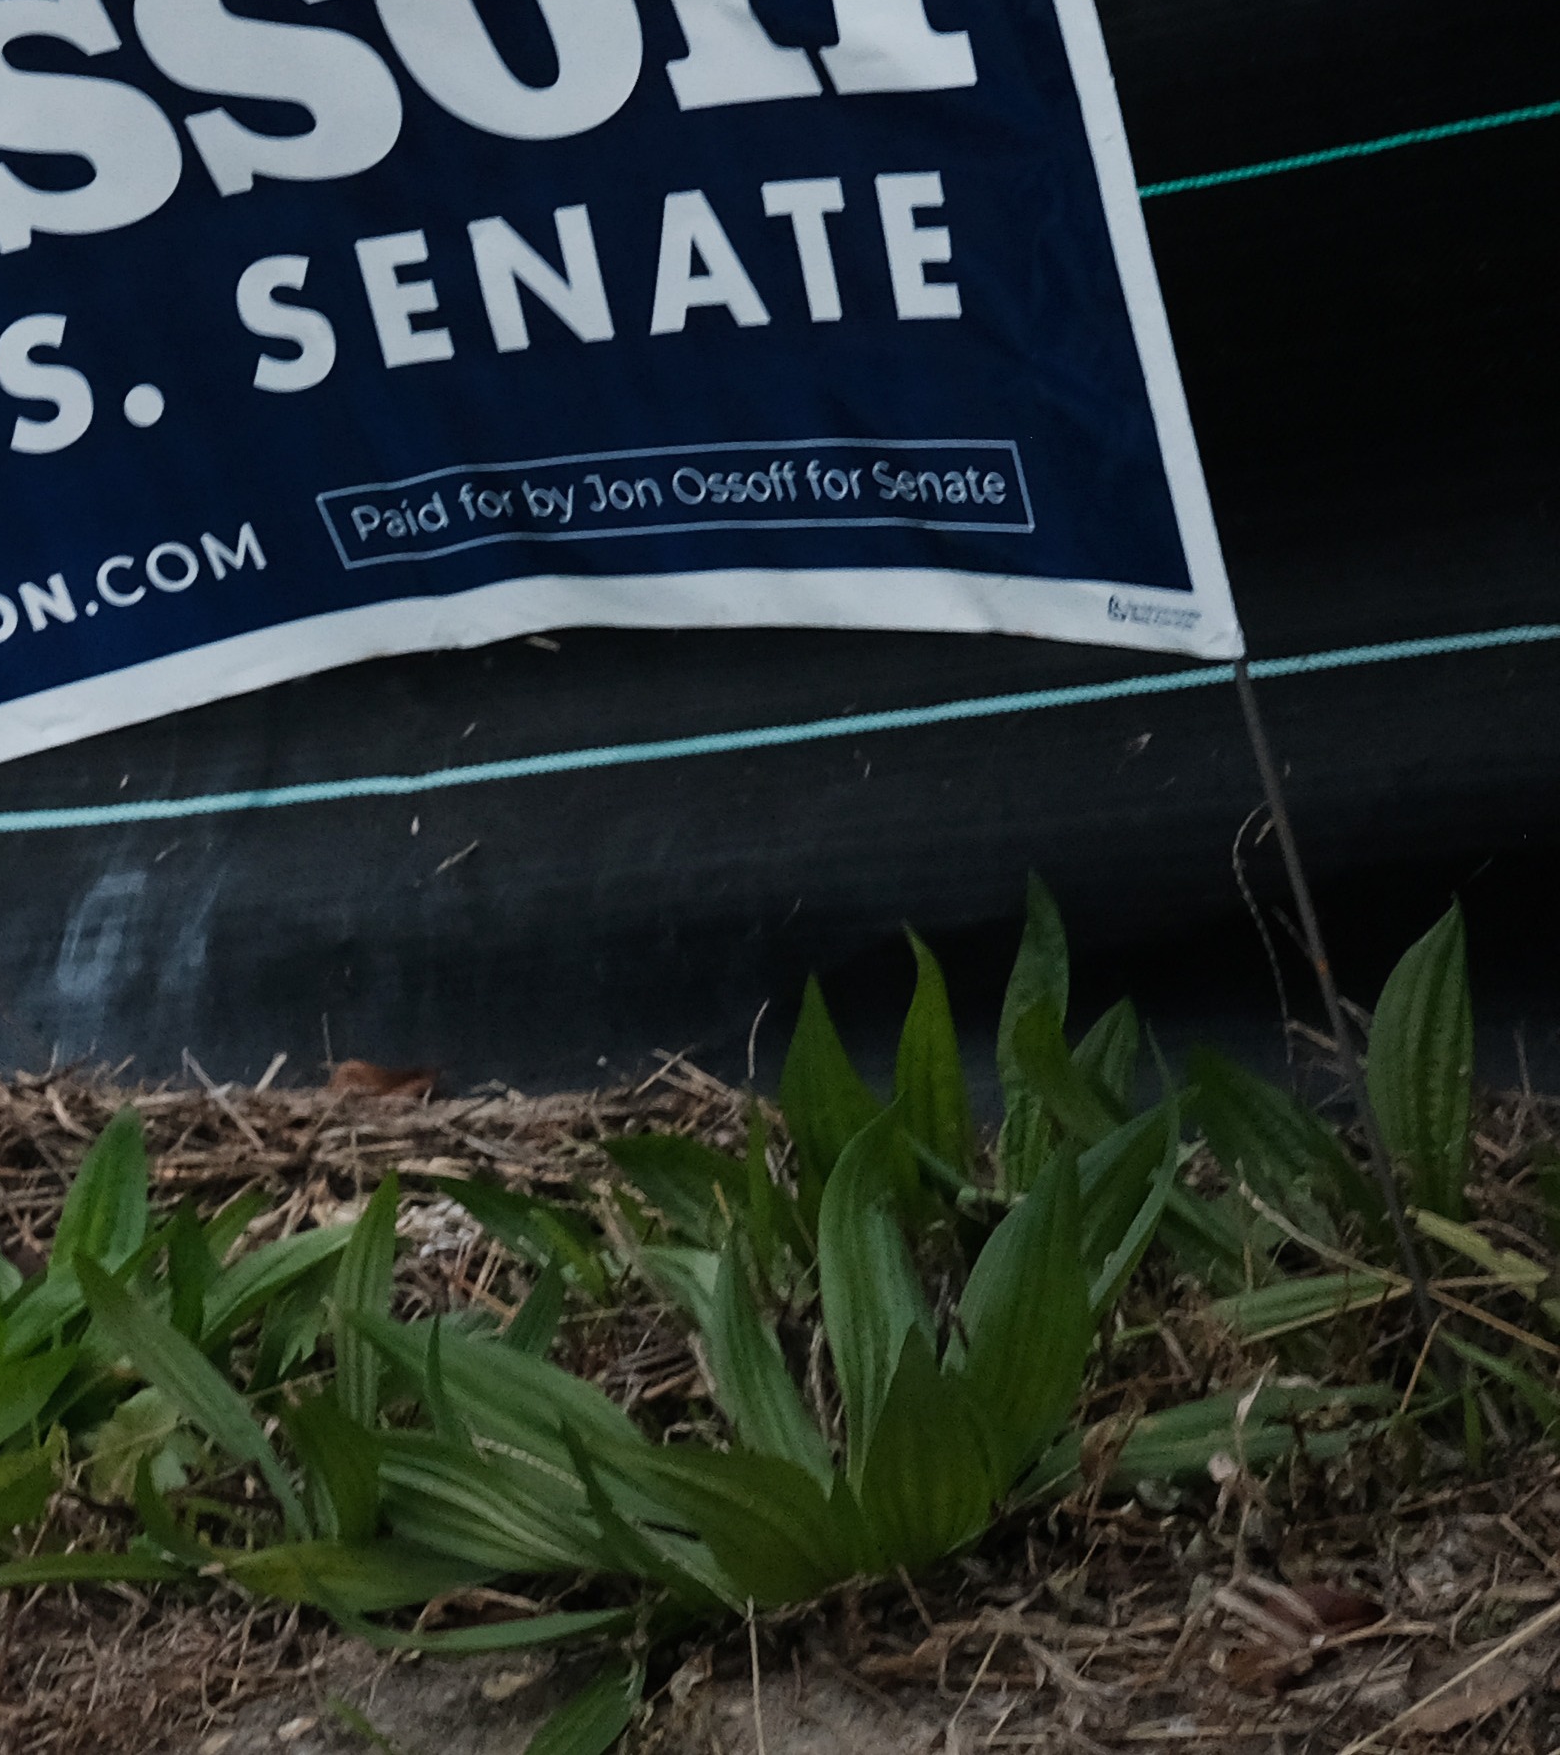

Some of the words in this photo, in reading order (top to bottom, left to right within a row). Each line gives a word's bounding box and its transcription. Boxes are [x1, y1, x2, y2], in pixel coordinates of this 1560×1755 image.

[235, 171, 962, 393] SENATE
[350, 491, 449, 541] Paid
[459, 482, 514, 522] for
[521, 472, 574, 523] by
[584, 473, 663, 512] Jon
[672, 461, 797, 505] Ossoff
[805, 460, 862, 502] for
[871, 460, 1008, 505] Senate
